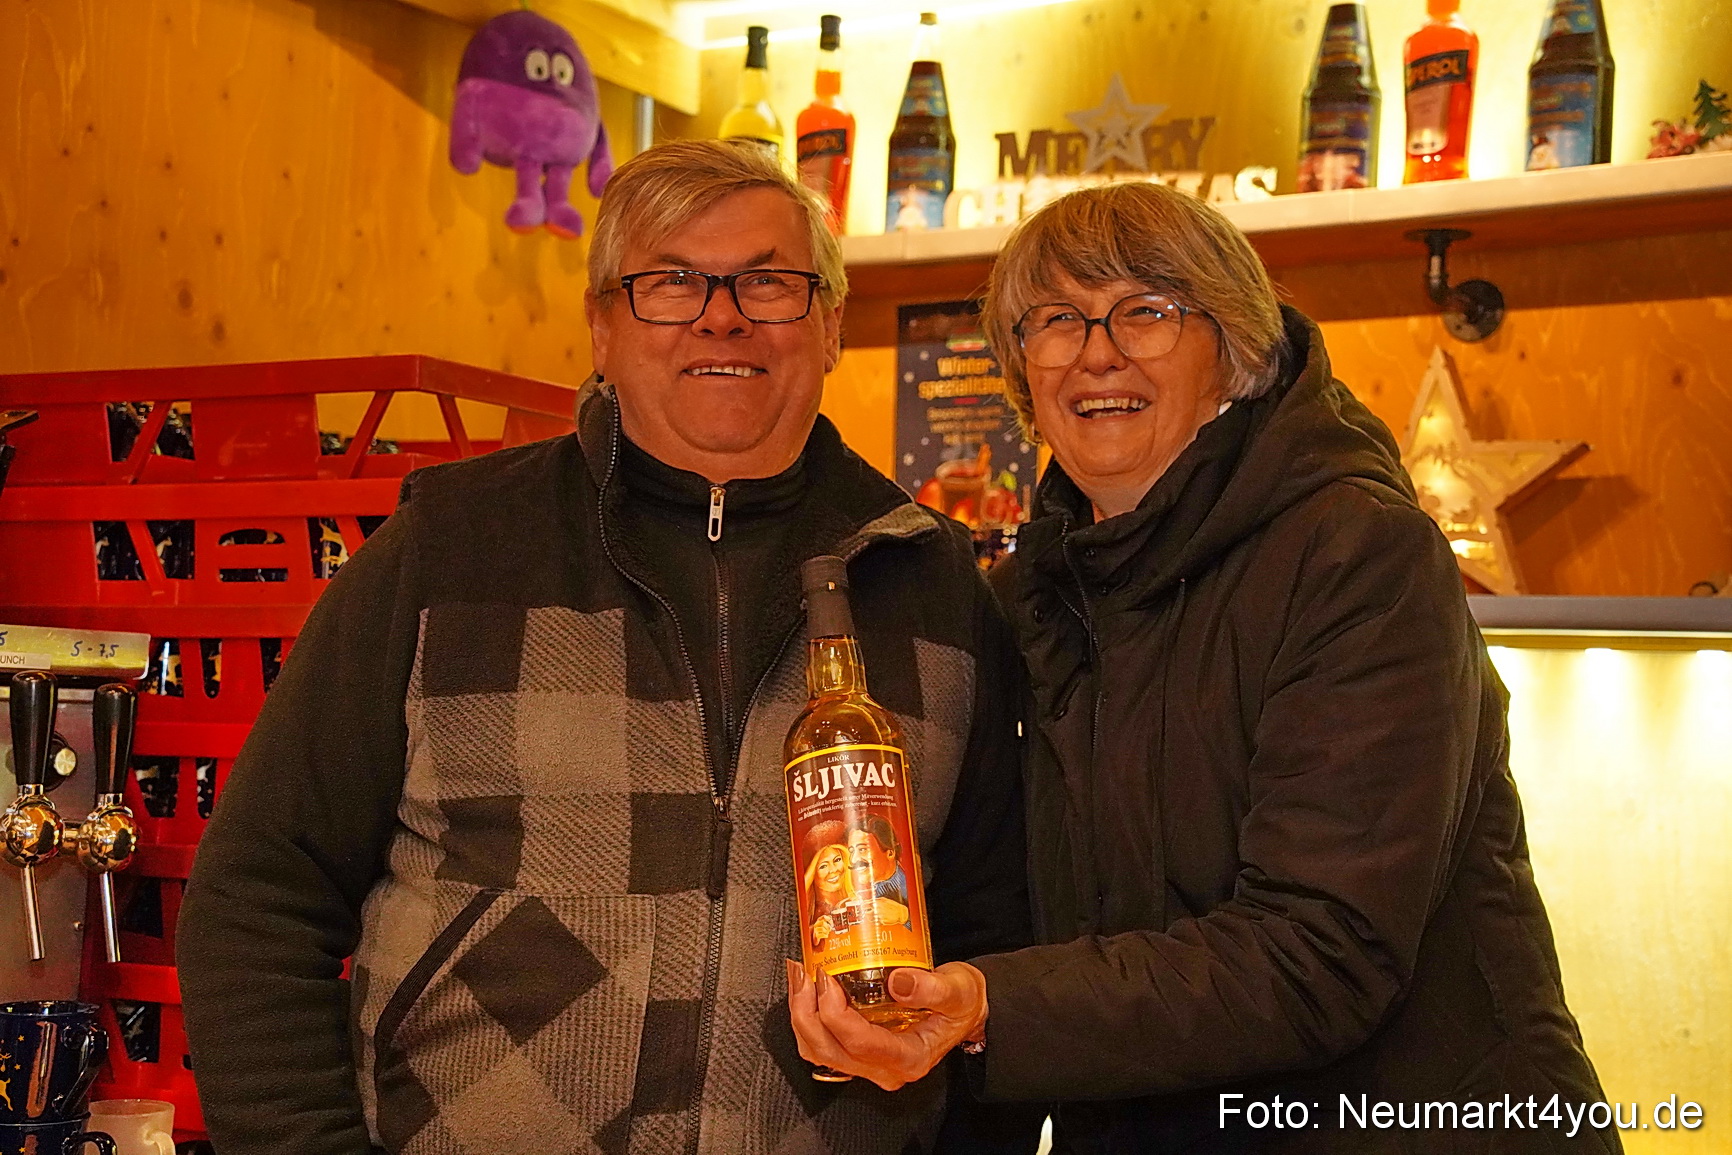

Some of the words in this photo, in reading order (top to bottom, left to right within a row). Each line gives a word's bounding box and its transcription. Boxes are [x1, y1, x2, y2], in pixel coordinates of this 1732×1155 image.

[937, 356, 996, 377] Winter-
[99, 643, 119, 658] 7,5
[827, 754, 850, 764] LIKÖR
[793, 762, 896, 802] ŠLJIVAC
[837, 950, 859, 962] GmbH
[891, 947, 918, 958] Augsburg
